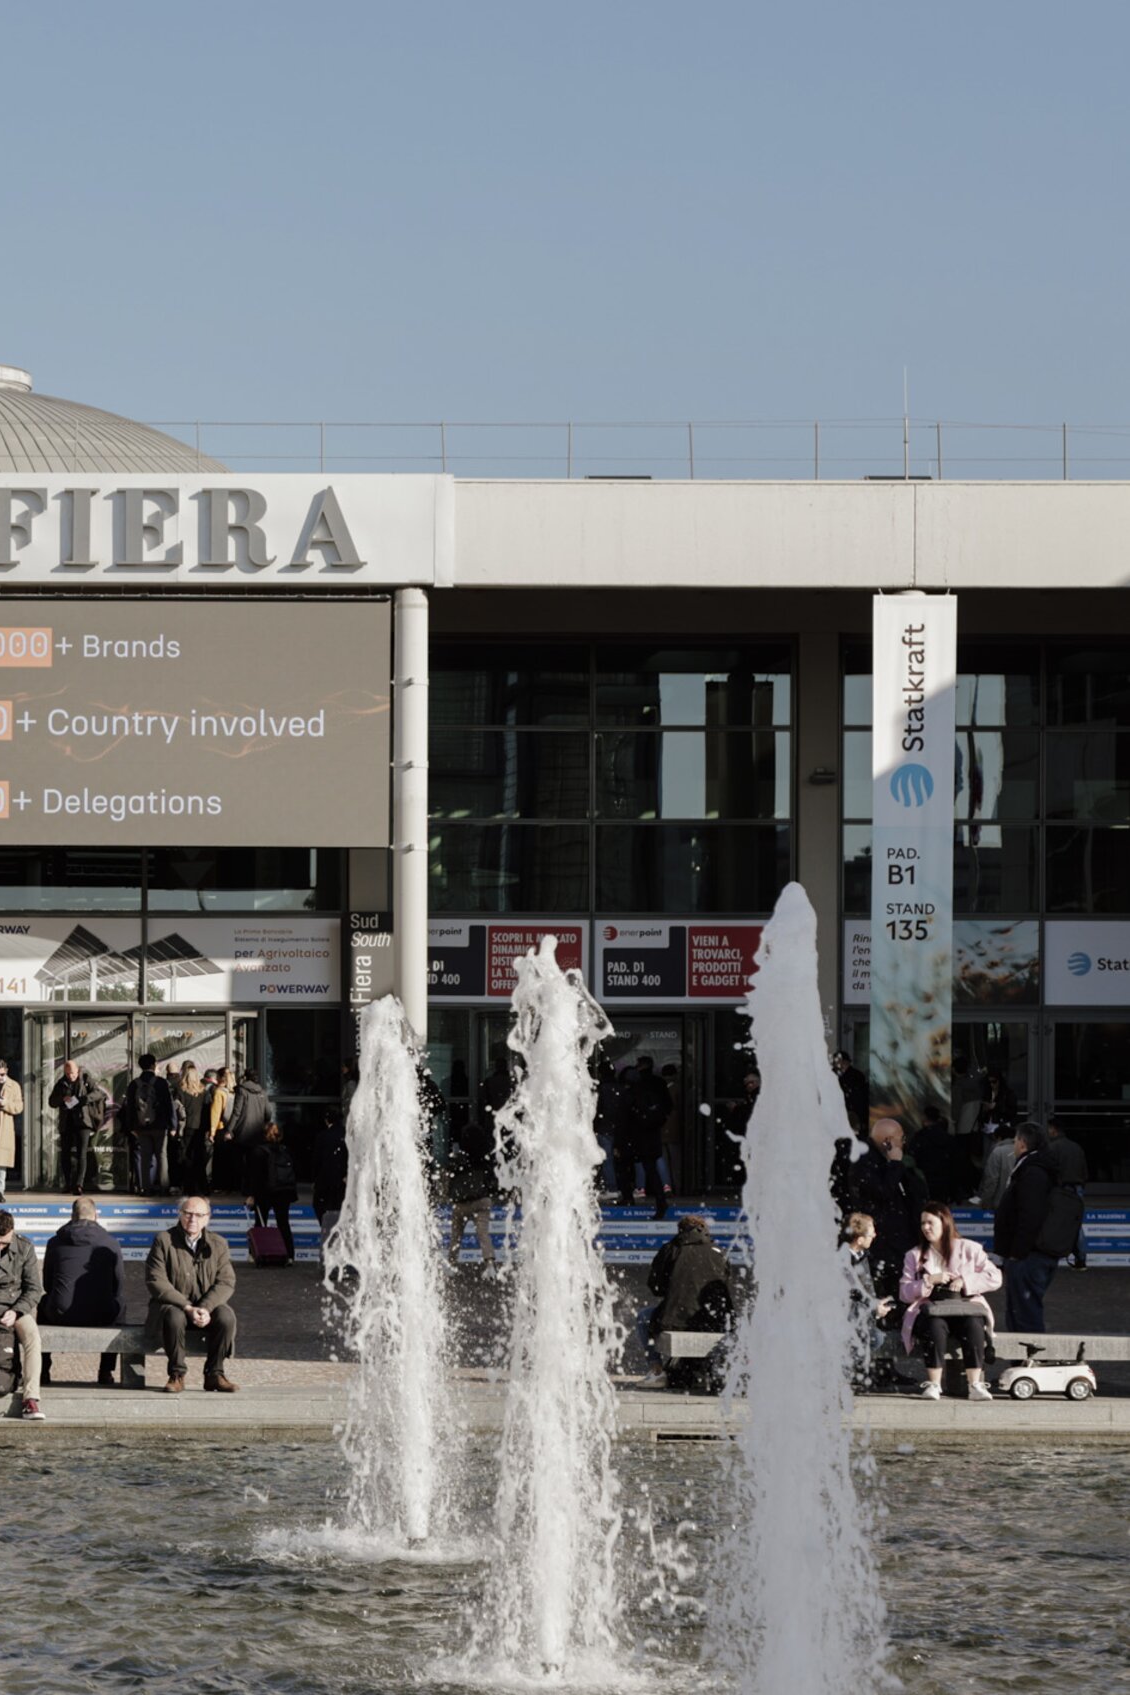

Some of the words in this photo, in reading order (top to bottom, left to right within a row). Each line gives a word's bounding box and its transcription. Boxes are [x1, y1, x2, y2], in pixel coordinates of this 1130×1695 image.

[83, 634, 181, 658] Brands
[902, 624, 925, 752] Statkraft
[48, 709, 178, 743] Country
[191, 710, 324, 737] involved
[43, 788, 222, 821] Delegations
[887, 848, 920, 859] PAD.
[888, 865, 915, 885] B1
[886, 903, 935, 915] STAND
[350, 913, 379, 929] Sud
[619, 928, 662, 938] enerpoint
[886, 920, 928, 941] 135
[350, 932, 392, 947] South
[492, 933, 523, 943] SCOPRI
[525, 933, 534, 943] IL
[692, 935, 719, 946] VIENI
[721, 935, 729, 946] A
[234, 950, 254, 960] per
[258, 948, 330, 960] Agrivoltaico
[692, 949, 743, 961] TROVARCI,
[234, 963, 291, 972] Avanzato
[433, 961, 444, 971] D1
[607, 962, 630, 973] PAD.
[633, 962, 645, 973] D1
[692, 962, 741, 973] PRODOTTI
[1097, 957, 1130, 971] Stat
[492, 968, 503, 978] LA
[350, 955, 372, 1003] Fiera
[441, 974, 460, 984] 400
[607, 975, 639, 986] STAND
[641, 975, 661, 986] 400
[692, 975, 698, 986] E
[701, 975, 739, 986] GADGET
[259, 984, 330, 993] POWERWAY
